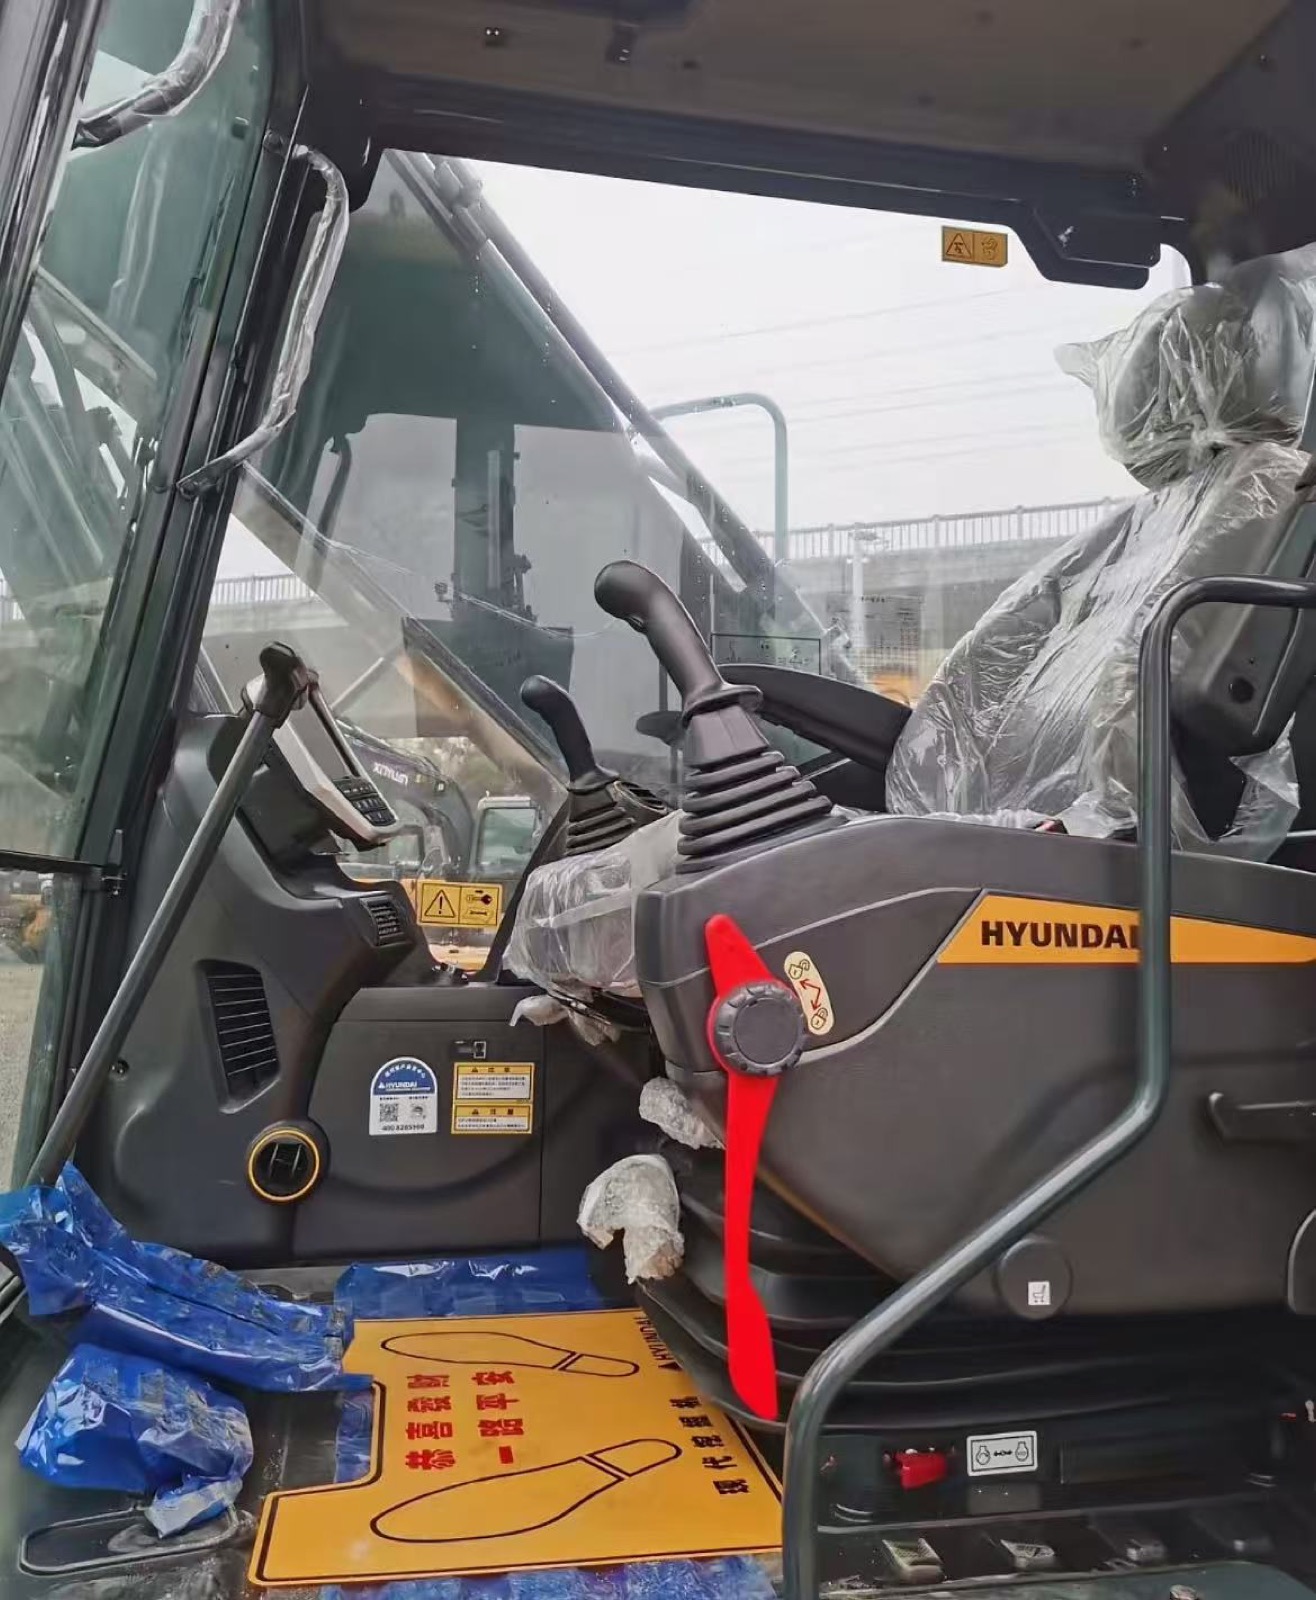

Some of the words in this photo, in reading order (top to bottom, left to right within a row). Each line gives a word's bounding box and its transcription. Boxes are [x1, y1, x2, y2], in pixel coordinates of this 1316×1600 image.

[405, 1374, 456, 1470] 恭喜發財
[471, 1371, 524, 1464] 一路平安
